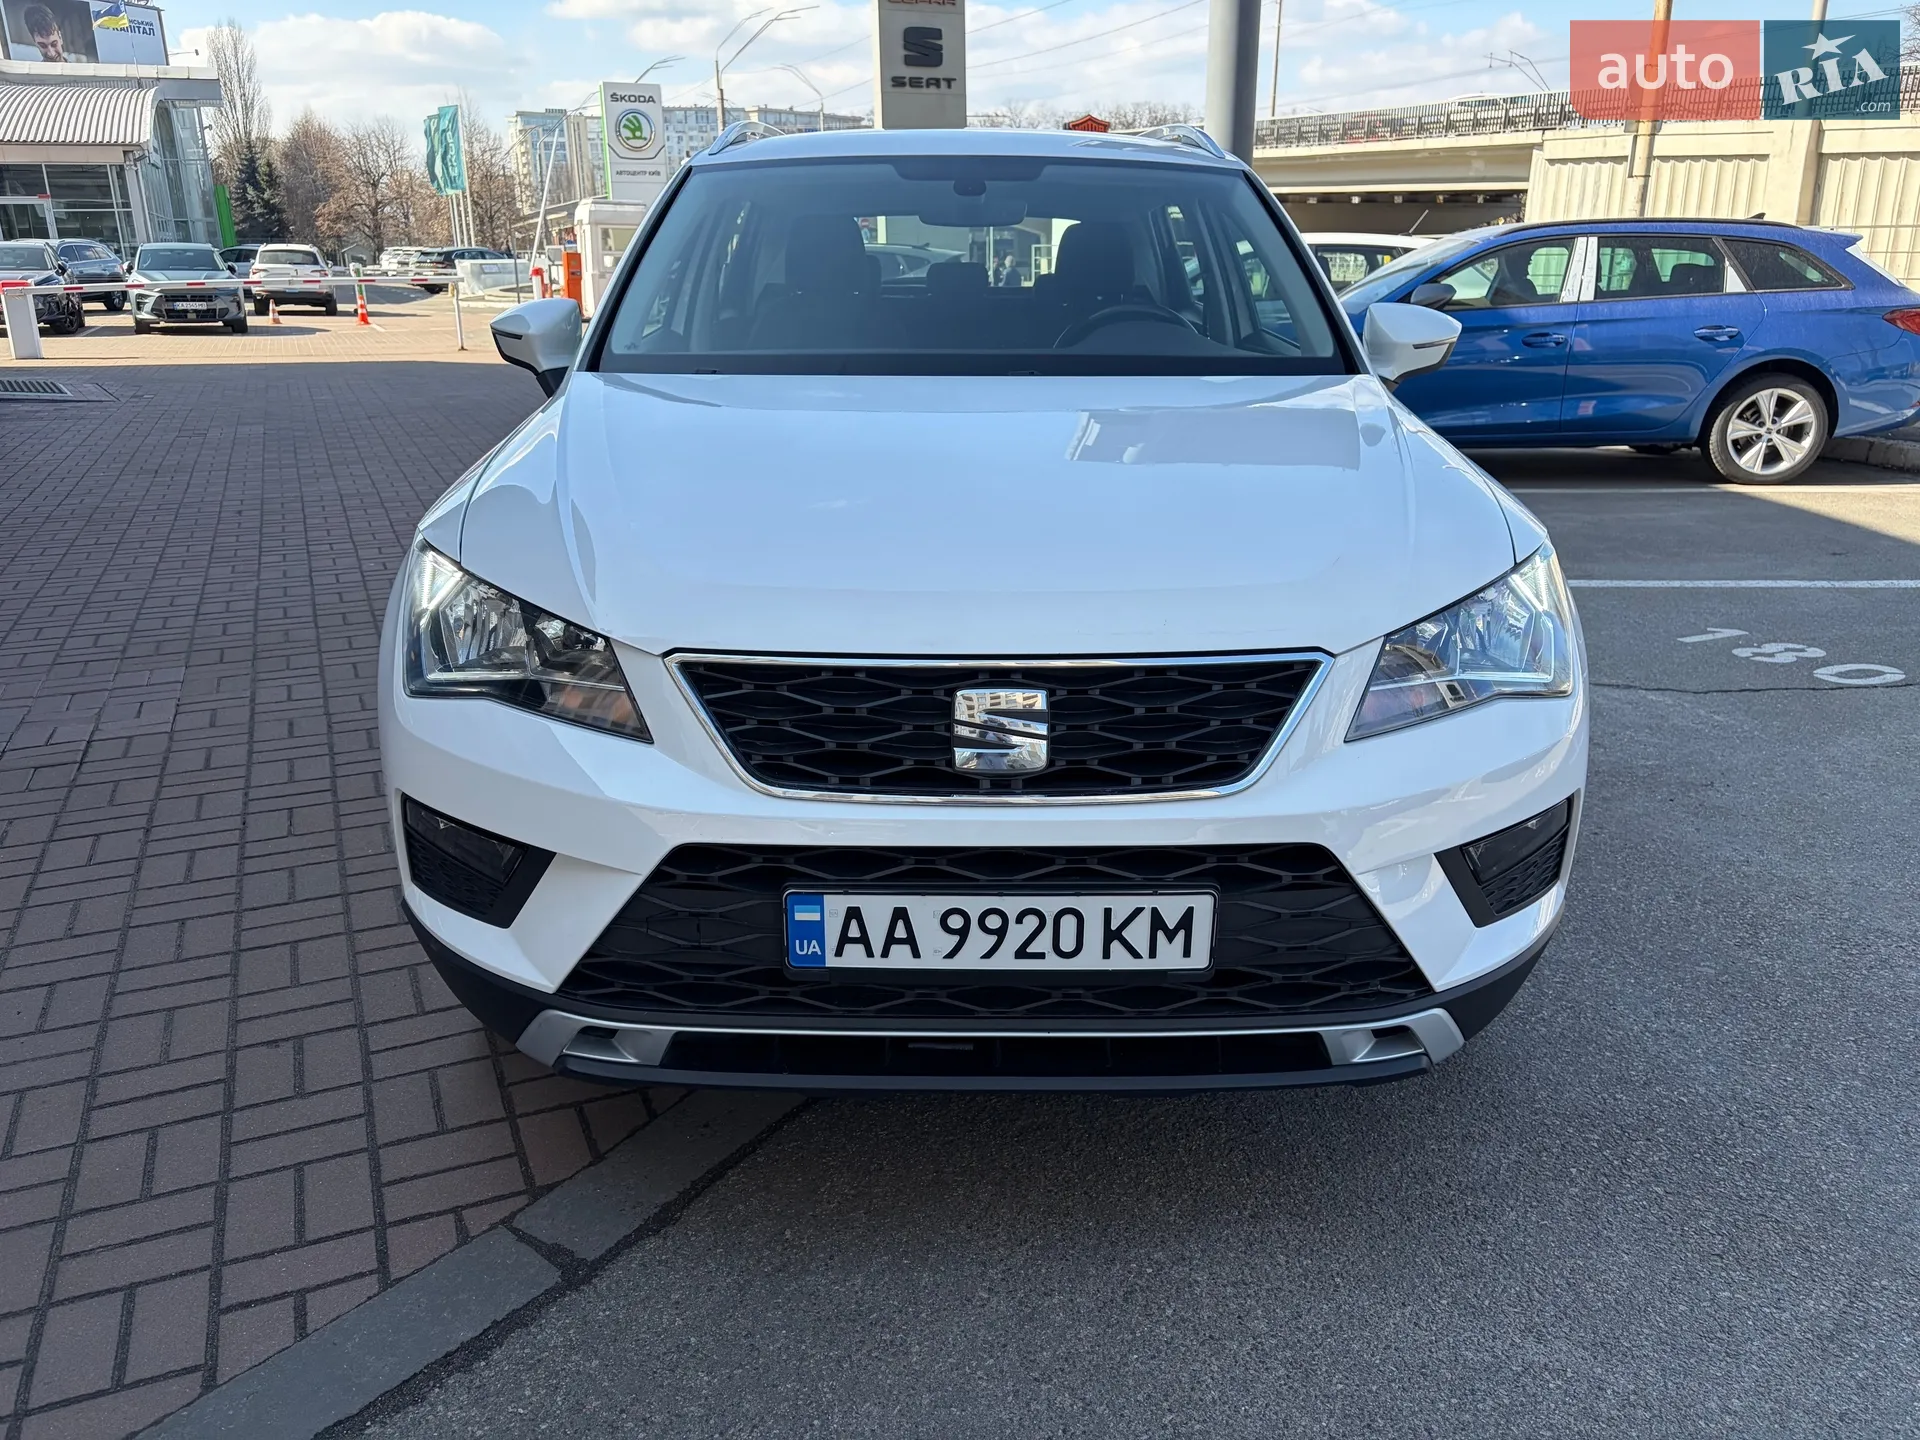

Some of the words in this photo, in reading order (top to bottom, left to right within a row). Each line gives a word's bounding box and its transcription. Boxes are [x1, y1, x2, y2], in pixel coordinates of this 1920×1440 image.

[890, 75, 957, 90] SEAT
[610, 92, 657, 104] ŠKODA
[795, 939, 822, 956] UA
[834, 906, 922, 959] AA
[939, 907, 1085, 960] 9920
[1102, 906, 1195, 960] KM
